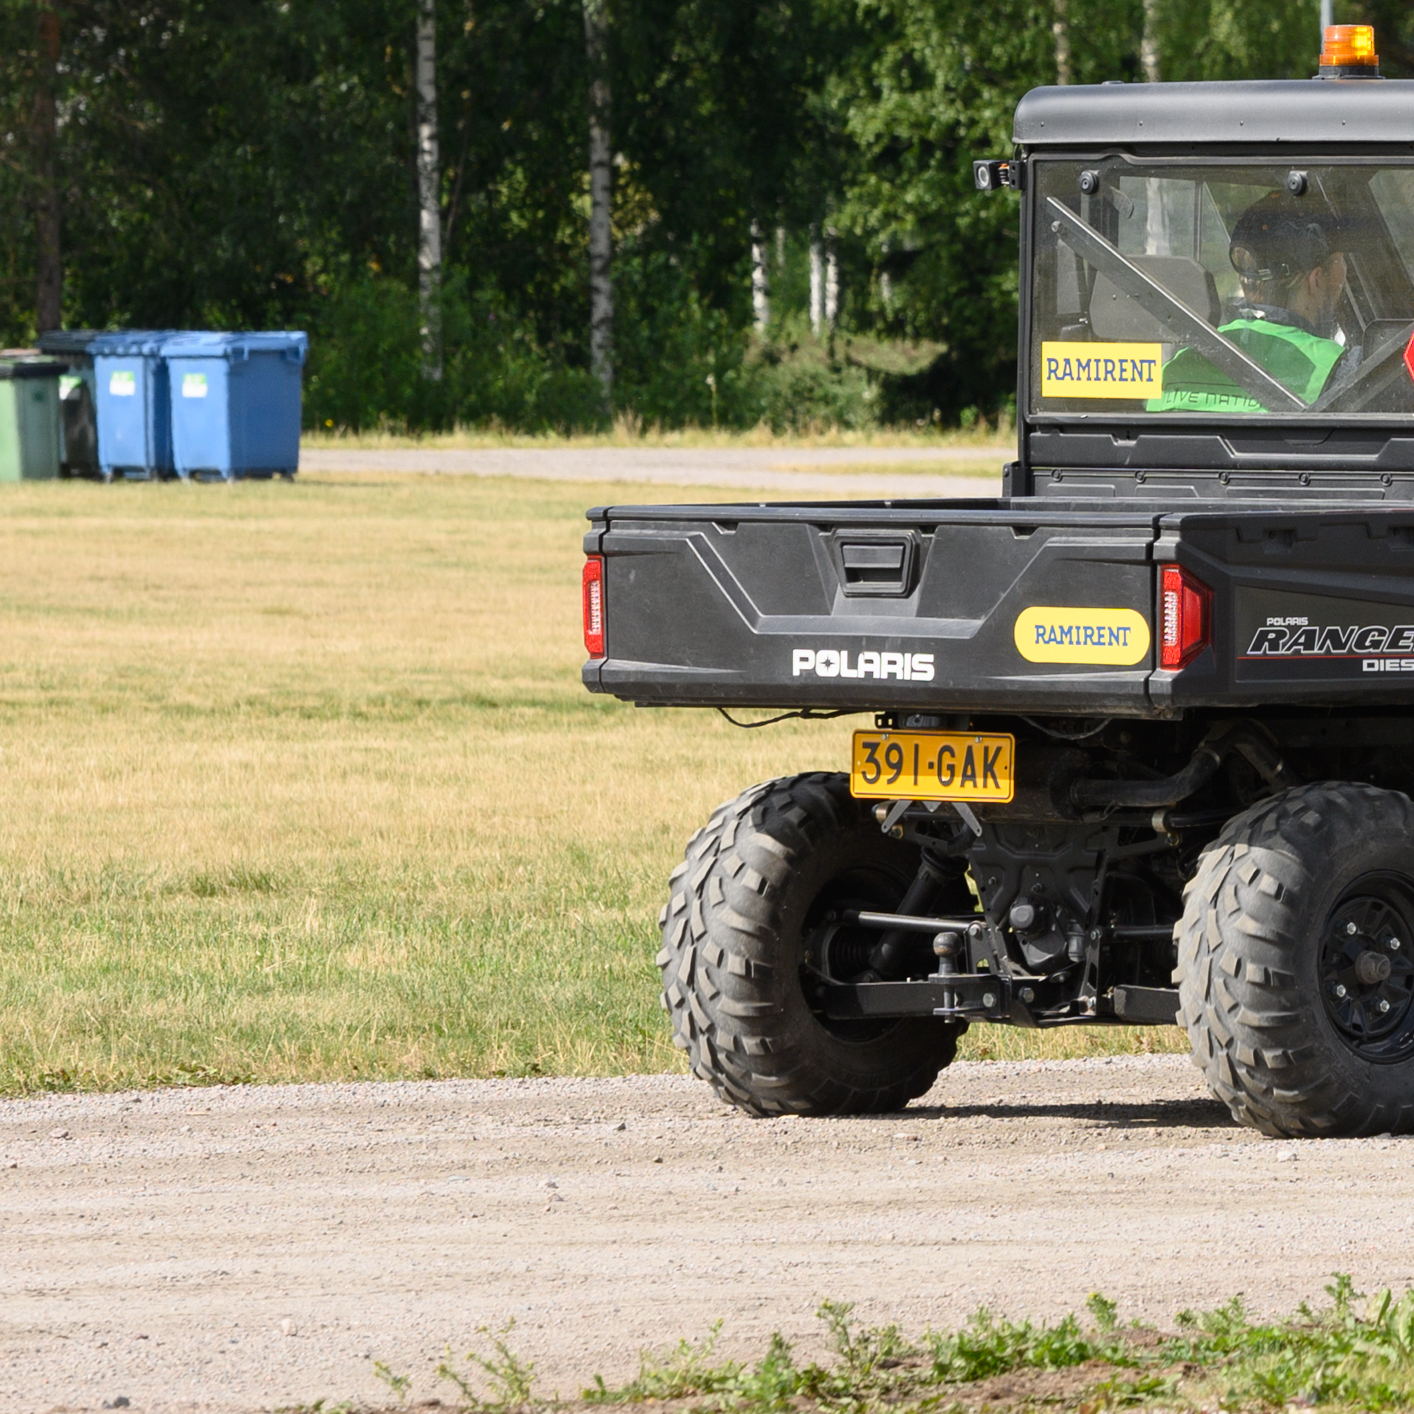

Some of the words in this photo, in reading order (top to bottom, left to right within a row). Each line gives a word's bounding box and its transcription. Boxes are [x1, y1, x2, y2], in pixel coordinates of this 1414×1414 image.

[1045, 357, 1157, 384] RAMIRENT
[1166, 387, 1200, 404] LIVE
[1205, 392, 1263, 408] NATIO
[1266, 616, 1309, 627] POLARIS
[1033, 623, 1132, 648] RAMIRENT
[792, 648, 935, 682] POLARIS
[861, 740, 1004, 791] 391-GAK
